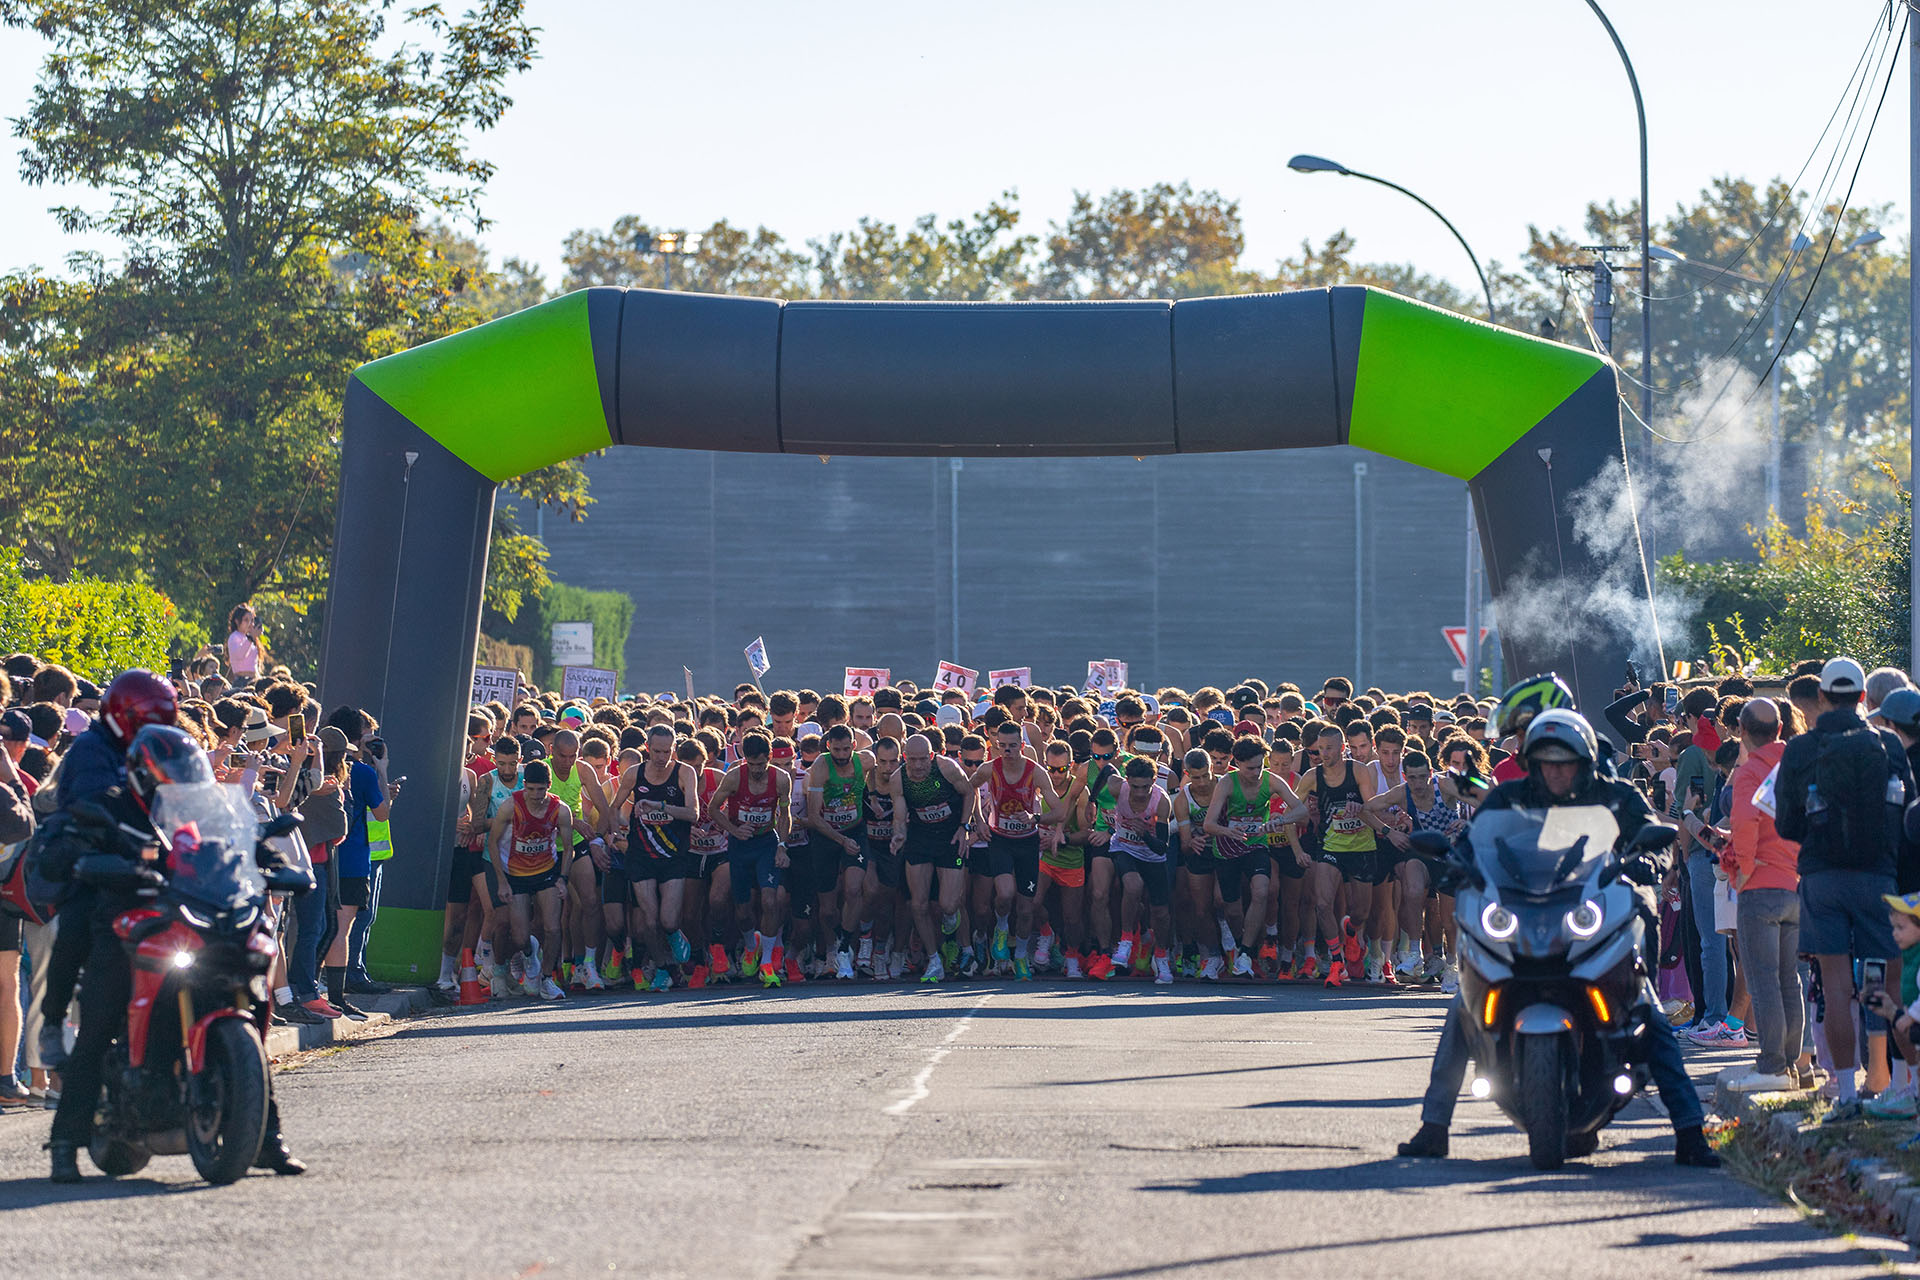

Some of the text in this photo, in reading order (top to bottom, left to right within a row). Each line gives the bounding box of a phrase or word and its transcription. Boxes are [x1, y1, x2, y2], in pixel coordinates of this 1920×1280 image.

[483, 676, 514, 689] ELITE
[582, 675, 614, 685] COMPET
[471, 689, 499, 704] H/F
[578, 685, 602, 698] H/F
[646, 813, 669, 821] 1009
[743, 814, 767, 823] 1082
[923, 809, 946, 820] 1057
[1003, 822, 1027, 830] 1089
[1338, 820, 1362, 830] 1024
[521, 844, 544, 853] 1038
